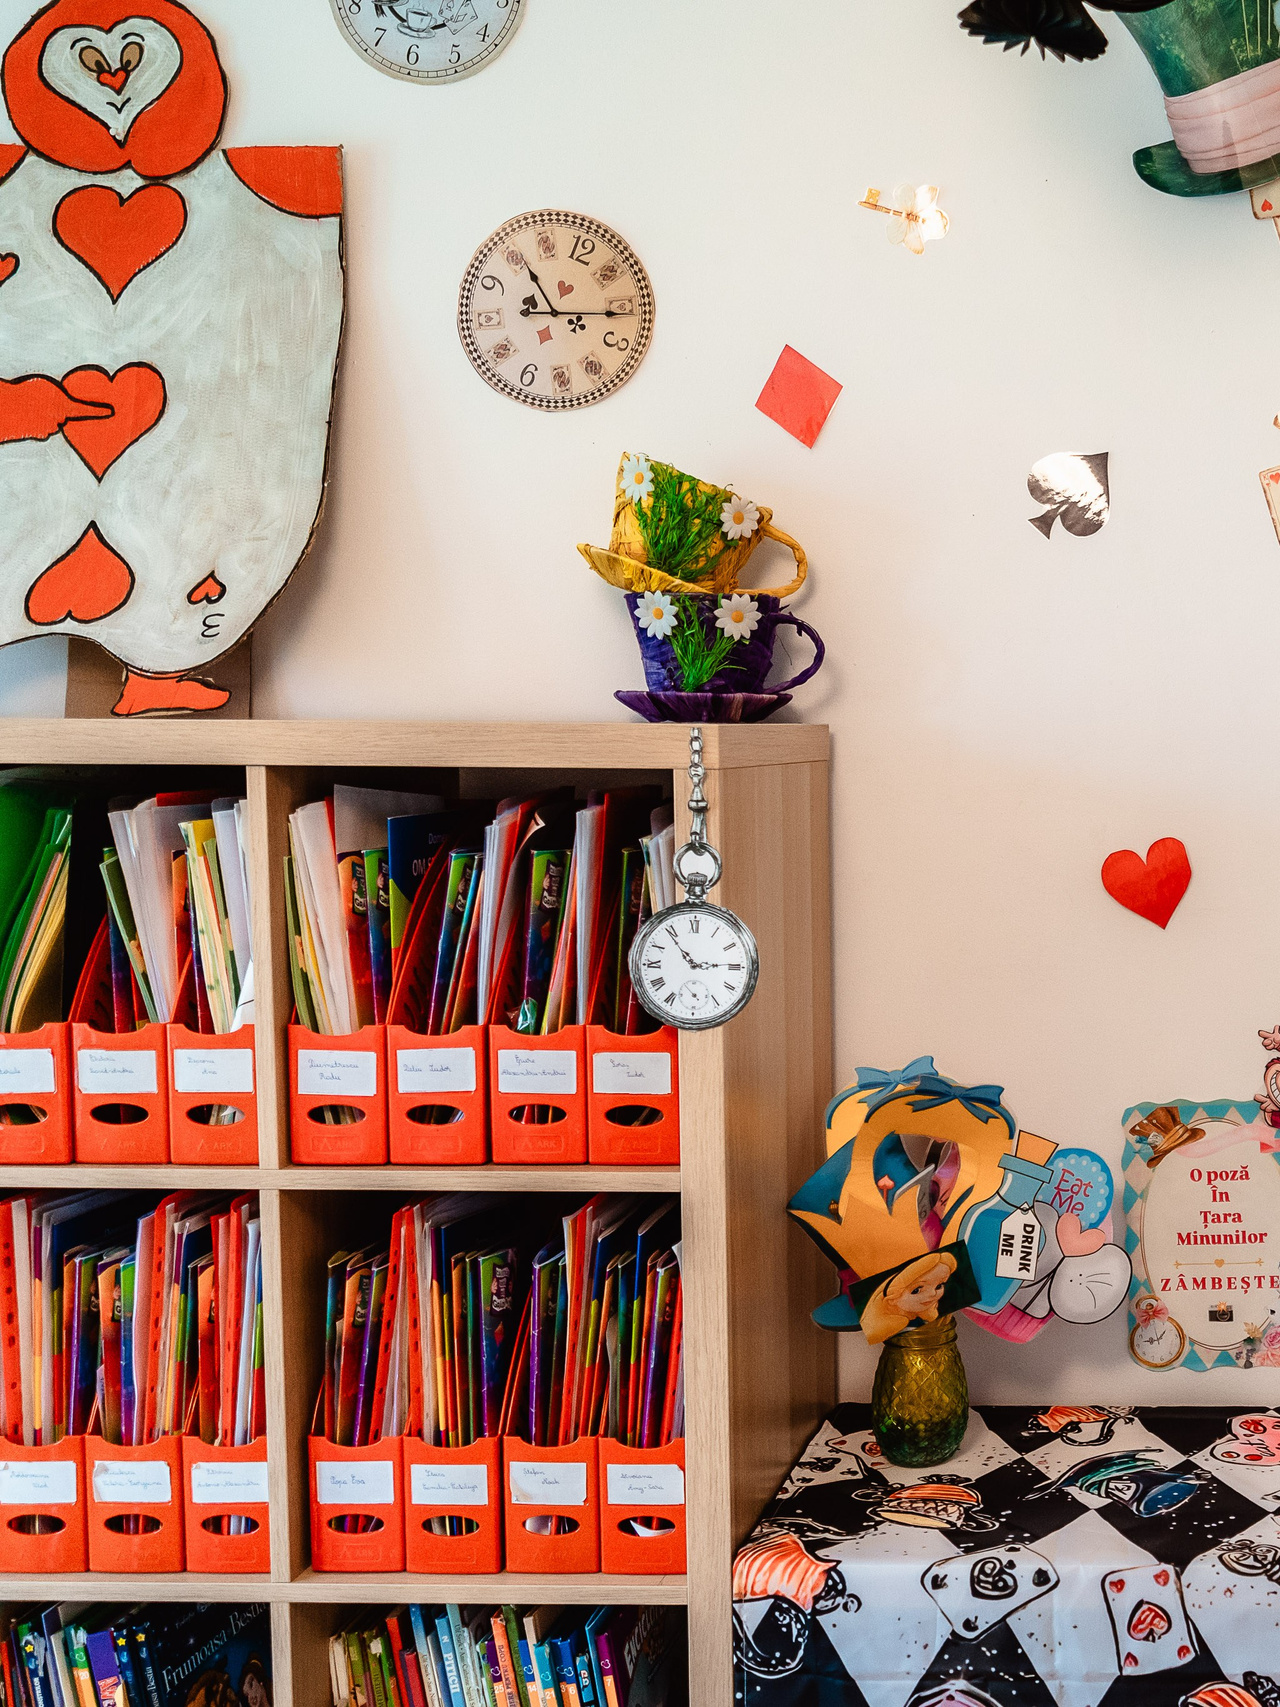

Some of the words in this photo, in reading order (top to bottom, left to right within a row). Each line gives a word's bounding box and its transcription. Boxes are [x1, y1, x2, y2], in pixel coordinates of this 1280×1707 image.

[374, 27, 387, 47] 7
[475, 22, 490, 43] 4
[406, 44, 420, 65] 6
[448, 44, 461, 64] 5
[567, 234, 596, 267] 12
[603, 331, 629, 352] 3
[520, 363, 538, 387] 6
[1054, 1168, 1093, 1197] Eat
[1190, 1168, 1202, 1182] O
[1206, 1165, 1250, 1185] poză
[1050, 1190, 1084, 1217] Me
[1210, 1185, 1230, 1202] În
[1200, 1210, 1243, 1229] Țara
[1001, 1233, 1015, 1257] ME
[1177, 1230, 1268, 1245] Minunilor
[1018, 1223, 1035, 1273] DRINK
[1160, 1273, 1280, 1294] ZÂMBEȘTE
[161, 1628, 229, 1693] Frumoasa
[79, 1669, 90, 1681] 20
[606, 1677, 613, 1688] 7
[493, 1684, 505, 1695] 25
[527, 1684, 538, 1693] 14
[545, 1689, 555, 1700] 21
[569, 1686, 576, 1695] 6
